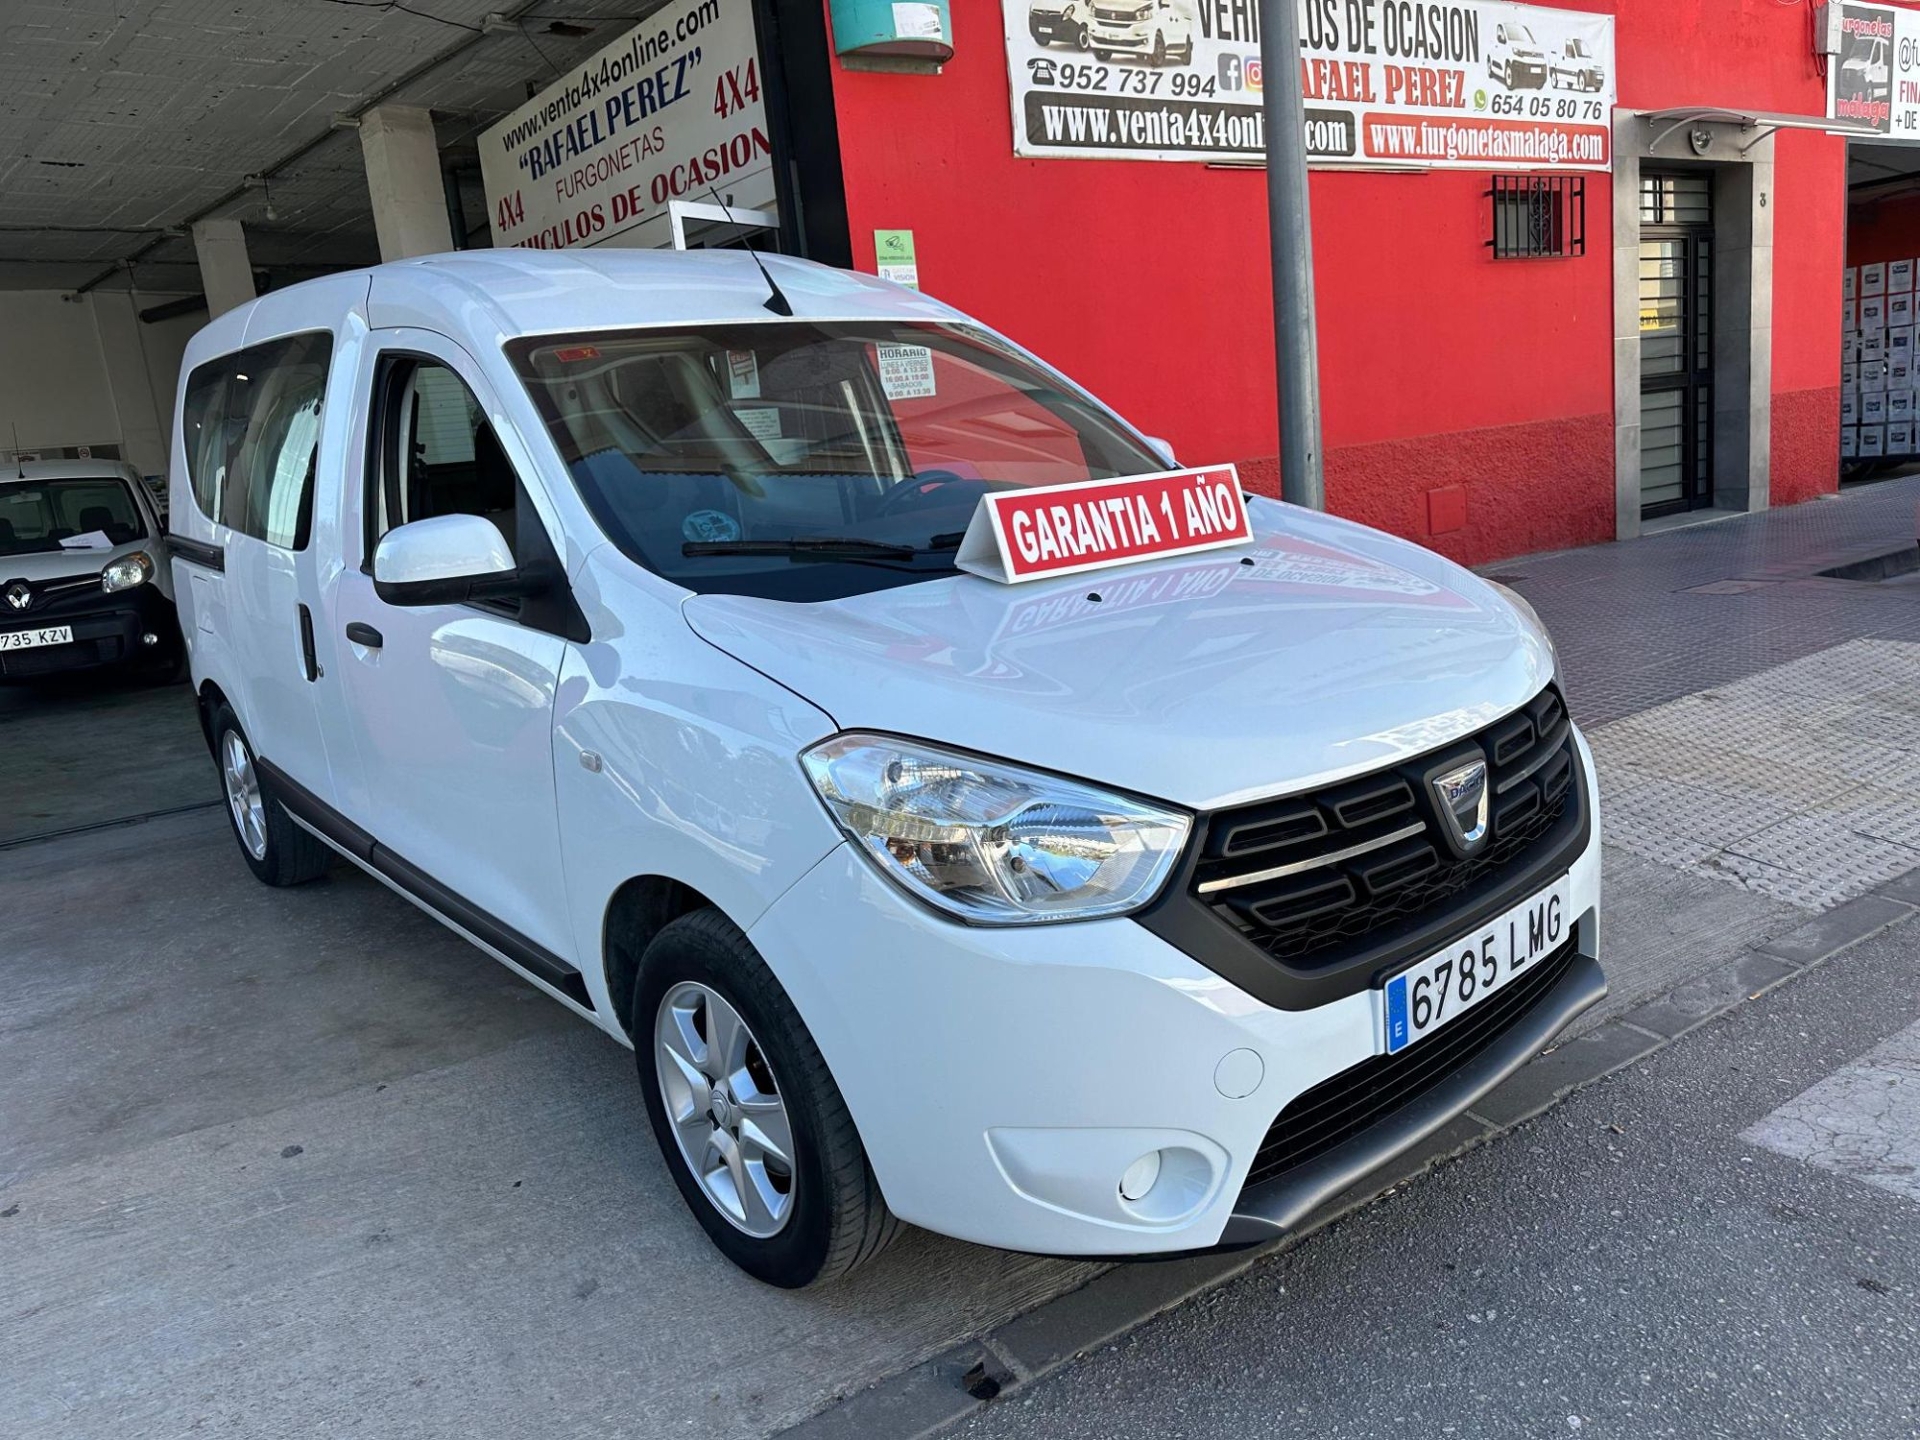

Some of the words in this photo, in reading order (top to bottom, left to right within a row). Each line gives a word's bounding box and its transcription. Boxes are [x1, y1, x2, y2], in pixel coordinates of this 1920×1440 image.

[1347, 0, 1377, 54] DE
[1383, 0, 1480, 63] OCASION
[1842, 16, 1892, 38] urgonetas
[502, 0, 720, 152] www.venta4x4online.com
[714, 57, 760, 119] 4X4
[1059, 62, 1109, 91] 952
[1118, 67, 1163, 94] 737
[1171, 72, 1217, 98] 994
[1300, 57, 1376, 103] AFAEL
[1384, 63, 1466, 109] PEREZ
[1899, 80, 1920, 104] FIN
[1491, 93, 1524, 116] 654
[1529, 96, 1550, 117] 05
[1556, 98, 1577, 119] 80
[1582, 100, 1603, 120] 76
[1904, 110, 1918, 130] DE
[1369, 121, 1603, 163] www.furgonetasmalaga.com
[555, 126, 665, 203] FURGONETAS
[611, 184, 645, 225] DE
[650, 126, 772, 205] OCASION
[498, 189, 525, 233] 4X4
[880, 348, 927, 358] HORARIO
[1012, 494, 1161, 564] GARANTIA
[1160, 490, 1180, 541] 1
[1182, 474, 1238, 538] AÑO
[38, 628, 69, 643] KZV
[1411, 934, 1498, 1030] 6785
[1508, 894, 1561, 972] LMG
[1394, 1021, 1403, 1038] E
